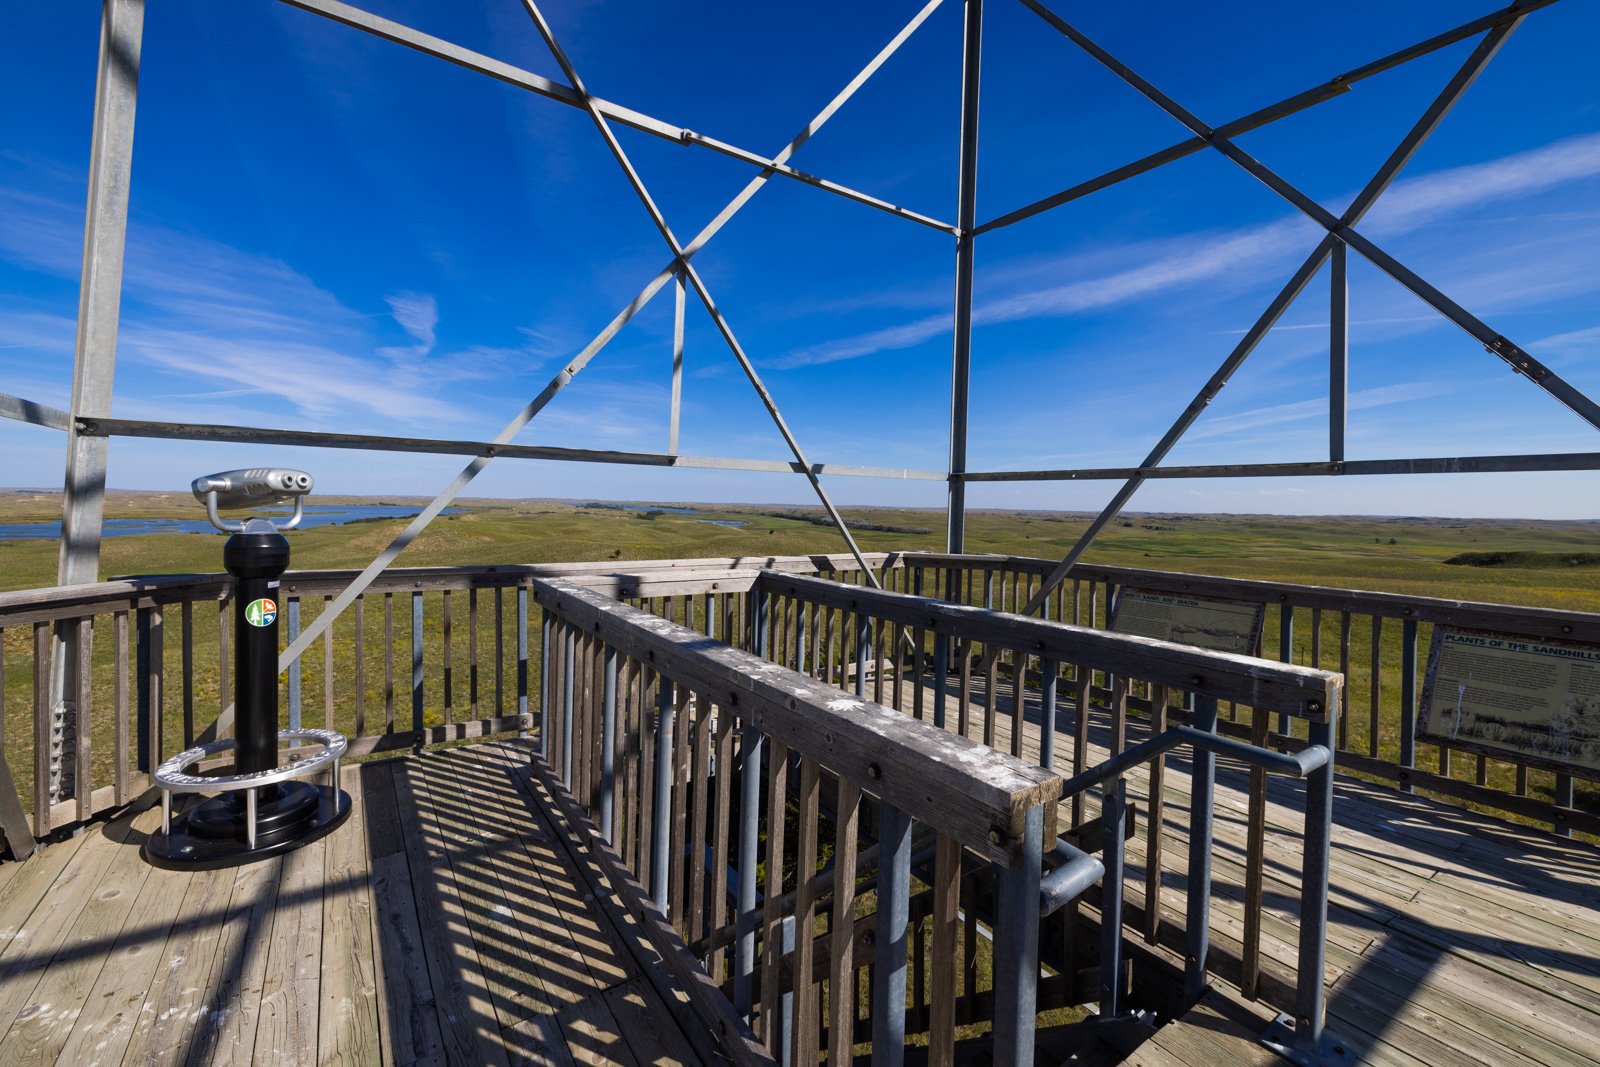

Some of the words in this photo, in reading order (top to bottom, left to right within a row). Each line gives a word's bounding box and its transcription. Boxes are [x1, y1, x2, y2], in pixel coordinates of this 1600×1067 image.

[1445, 634, 1485, 645] PLANTS
[1508, 642, 1528, 651] THE
[1532, 645, 1600, 660] SANDHILLS
